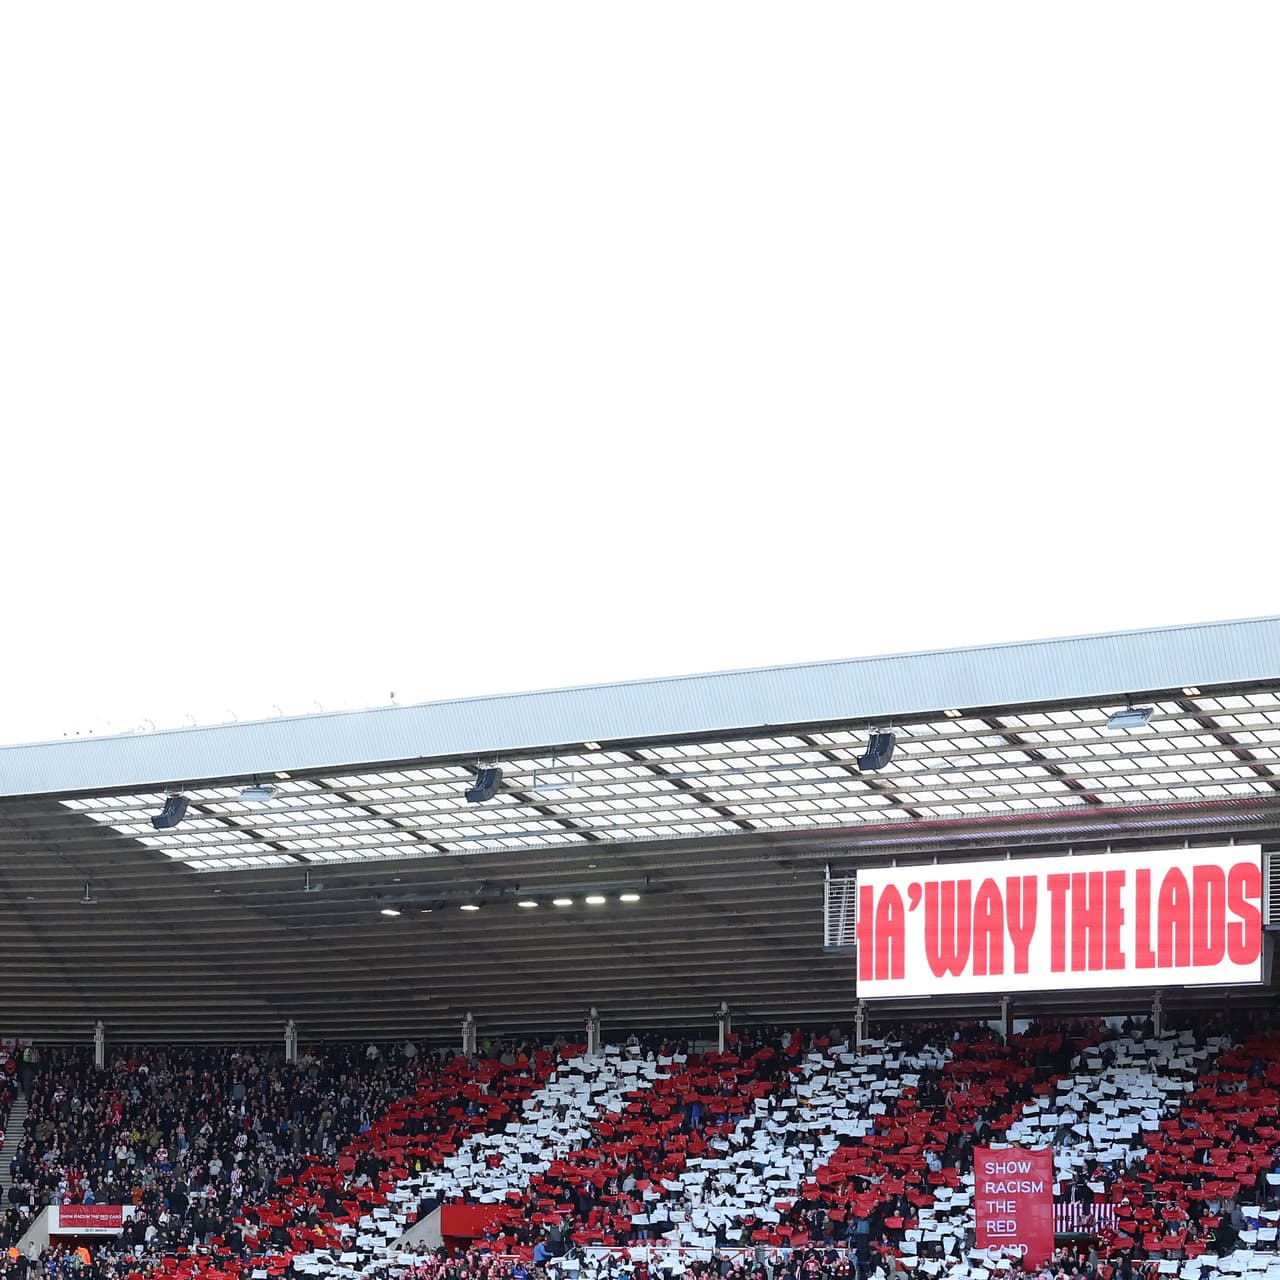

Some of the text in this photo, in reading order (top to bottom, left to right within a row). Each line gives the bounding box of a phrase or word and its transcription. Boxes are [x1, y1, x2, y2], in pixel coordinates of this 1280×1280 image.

[1047, 870, 1125, 972] THE
[1135, 861, 1262, 969] LADS
[985, 1162, 1032, 1175] SHOW
[985, 1181, 1044, 1194] RACISM
[986, 1200, 1016, 1213] THE
[986, 1220, 1017, 1233] RED
